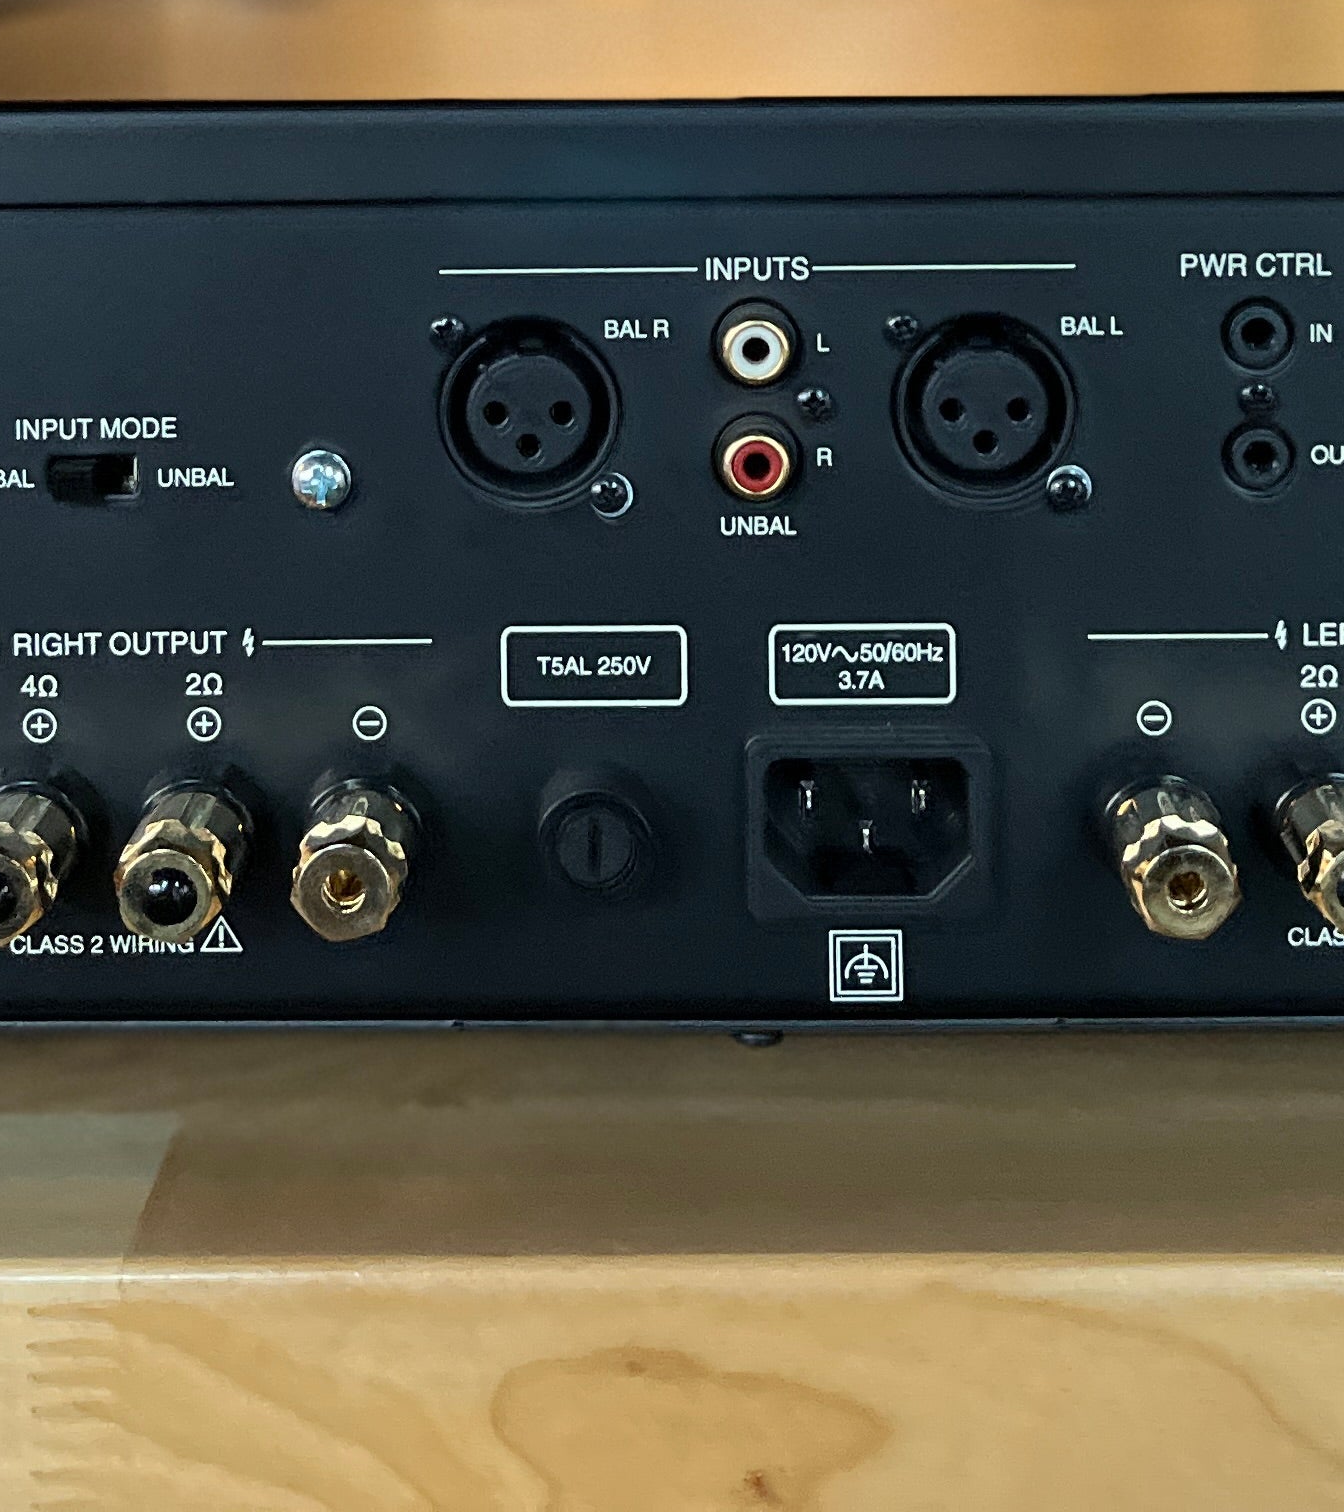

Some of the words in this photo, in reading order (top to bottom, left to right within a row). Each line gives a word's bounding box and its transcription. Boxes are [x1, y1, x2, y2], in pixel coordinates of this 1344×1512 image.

[706, 256, 809, 281] INPUTS
[1181, 253, 1247, 277] PWR
[1256, 253, 1332, 277] CTRL
[605, 320, 647, 338] BAL
[654, 319, 669, 338] R
[1061, 316, 1104, 335] BAL
[1111, 316, 1123, 335] L
[1310, 324, 1332, 342] IN
[817, 333, 829, 352] L
[16, 418, 93, 440] INPUT
[100, 417, 177, 439] MODE
[817, 448, 832, 466] R
[158, 468, 234, 487] UNBAL
[721, 516, 797, 535] UNBAL
[14, 632, 102, 656] RIGHT
[109, 631, 227, 656] OUTPUT
[537, 656, 592, 675] T5AL
[598, 656, 651, 675] 250V
[21, 675, 58, 697] 4Ω
[186, 673, 222, 695] 2Ω
[839, 670, 884, 690] 3.7A
[1300, 665, 1338, 688] 2Ω
[10, 935, 85, 955] CLASS
[90, 935, 104, 954] 2
